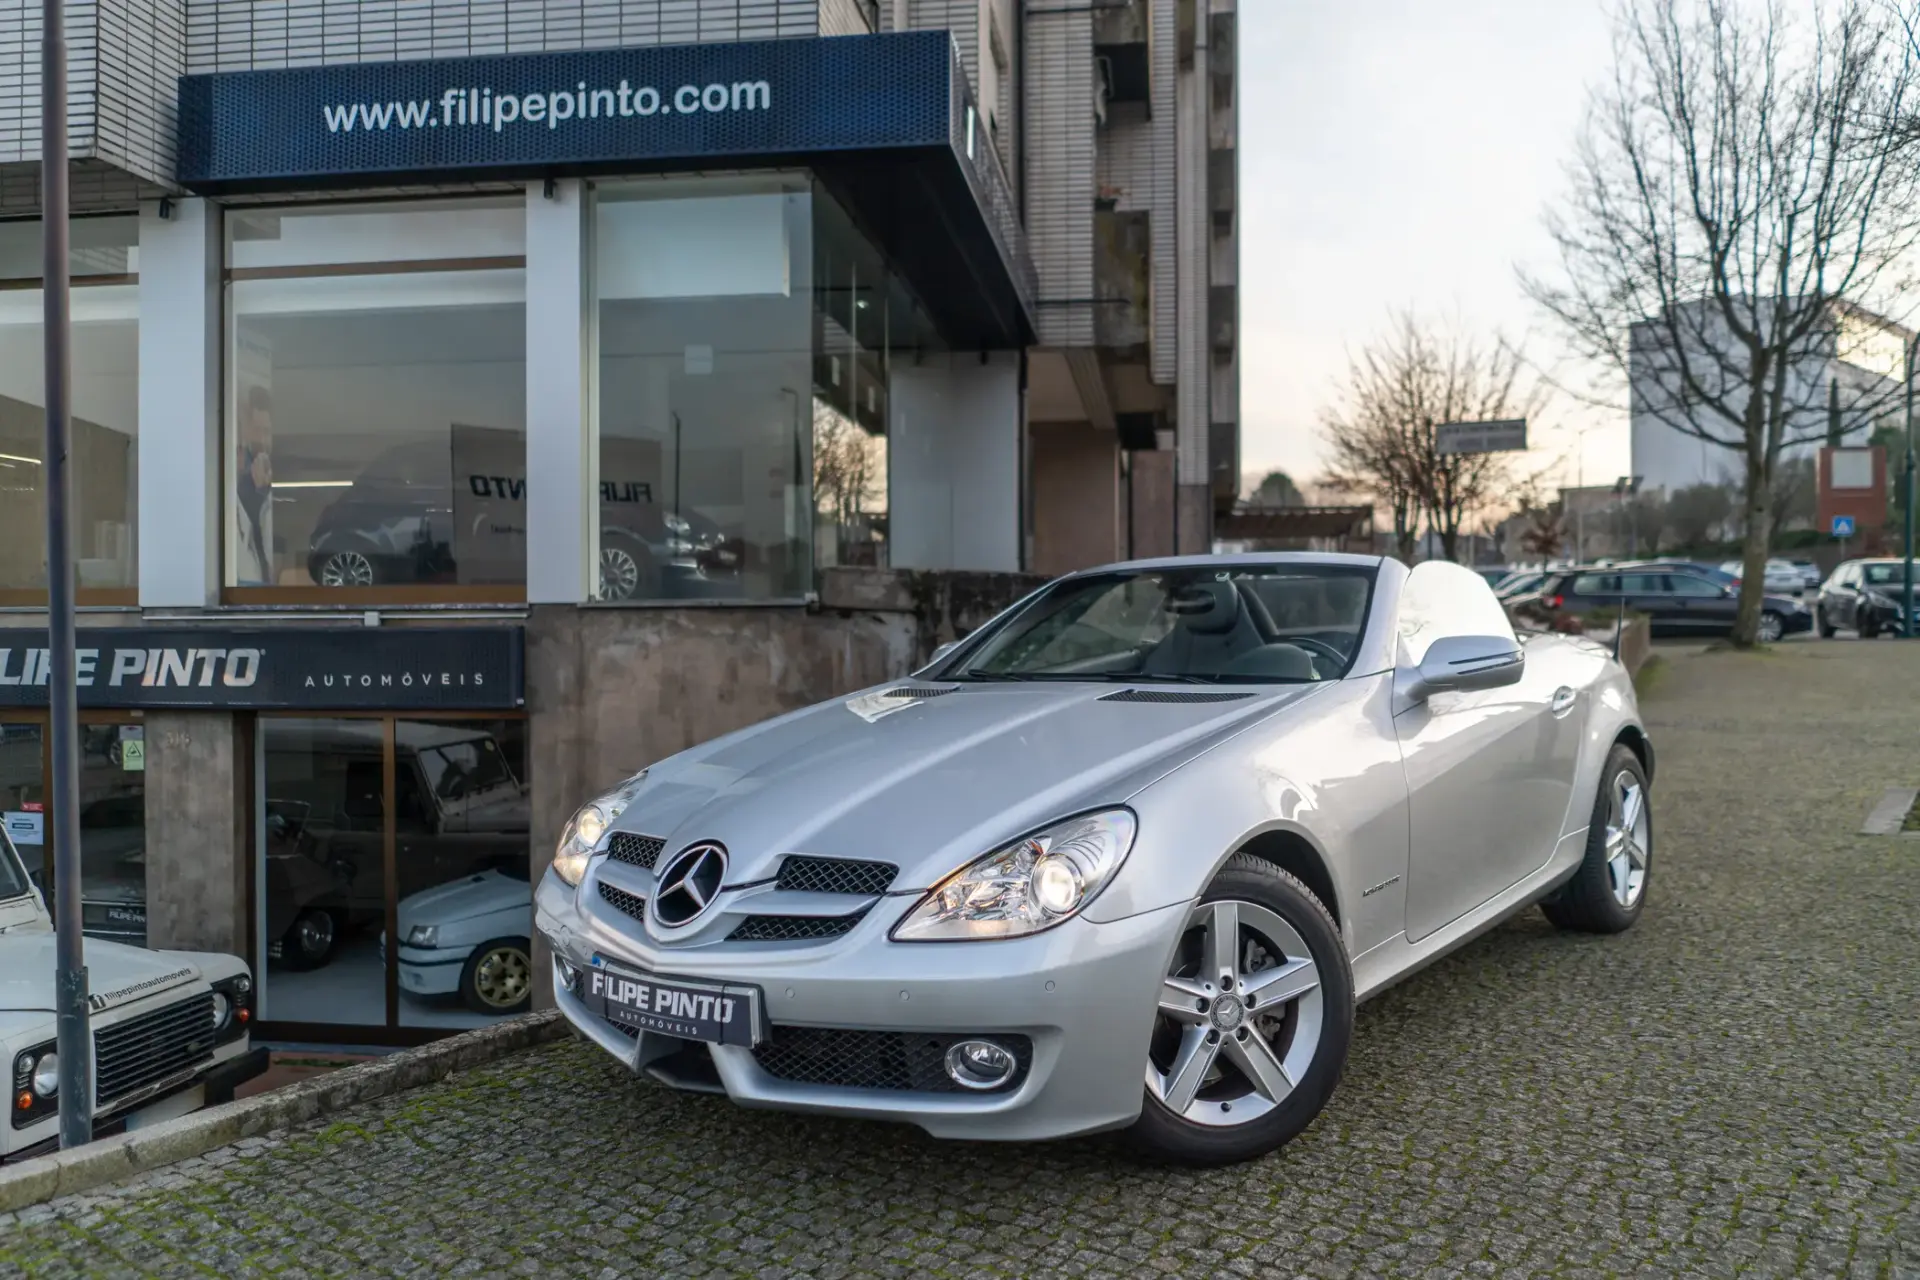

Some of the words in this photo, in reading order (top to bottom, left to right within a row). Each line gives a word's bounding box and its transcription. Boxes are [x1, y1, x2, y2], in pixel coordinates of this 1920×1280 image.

[323, 79, 771, 133] www.filipepinto.com
[108, 648, 262, 687] PINTO
[304, 671, 484, 688] AUTOMÓVEIS
[591, 971, 650, 1010] FILIPE
[655, 987, 734, 1024] PINTO
[619, 1010, 698, 1035] AUTOMÓVEIS
